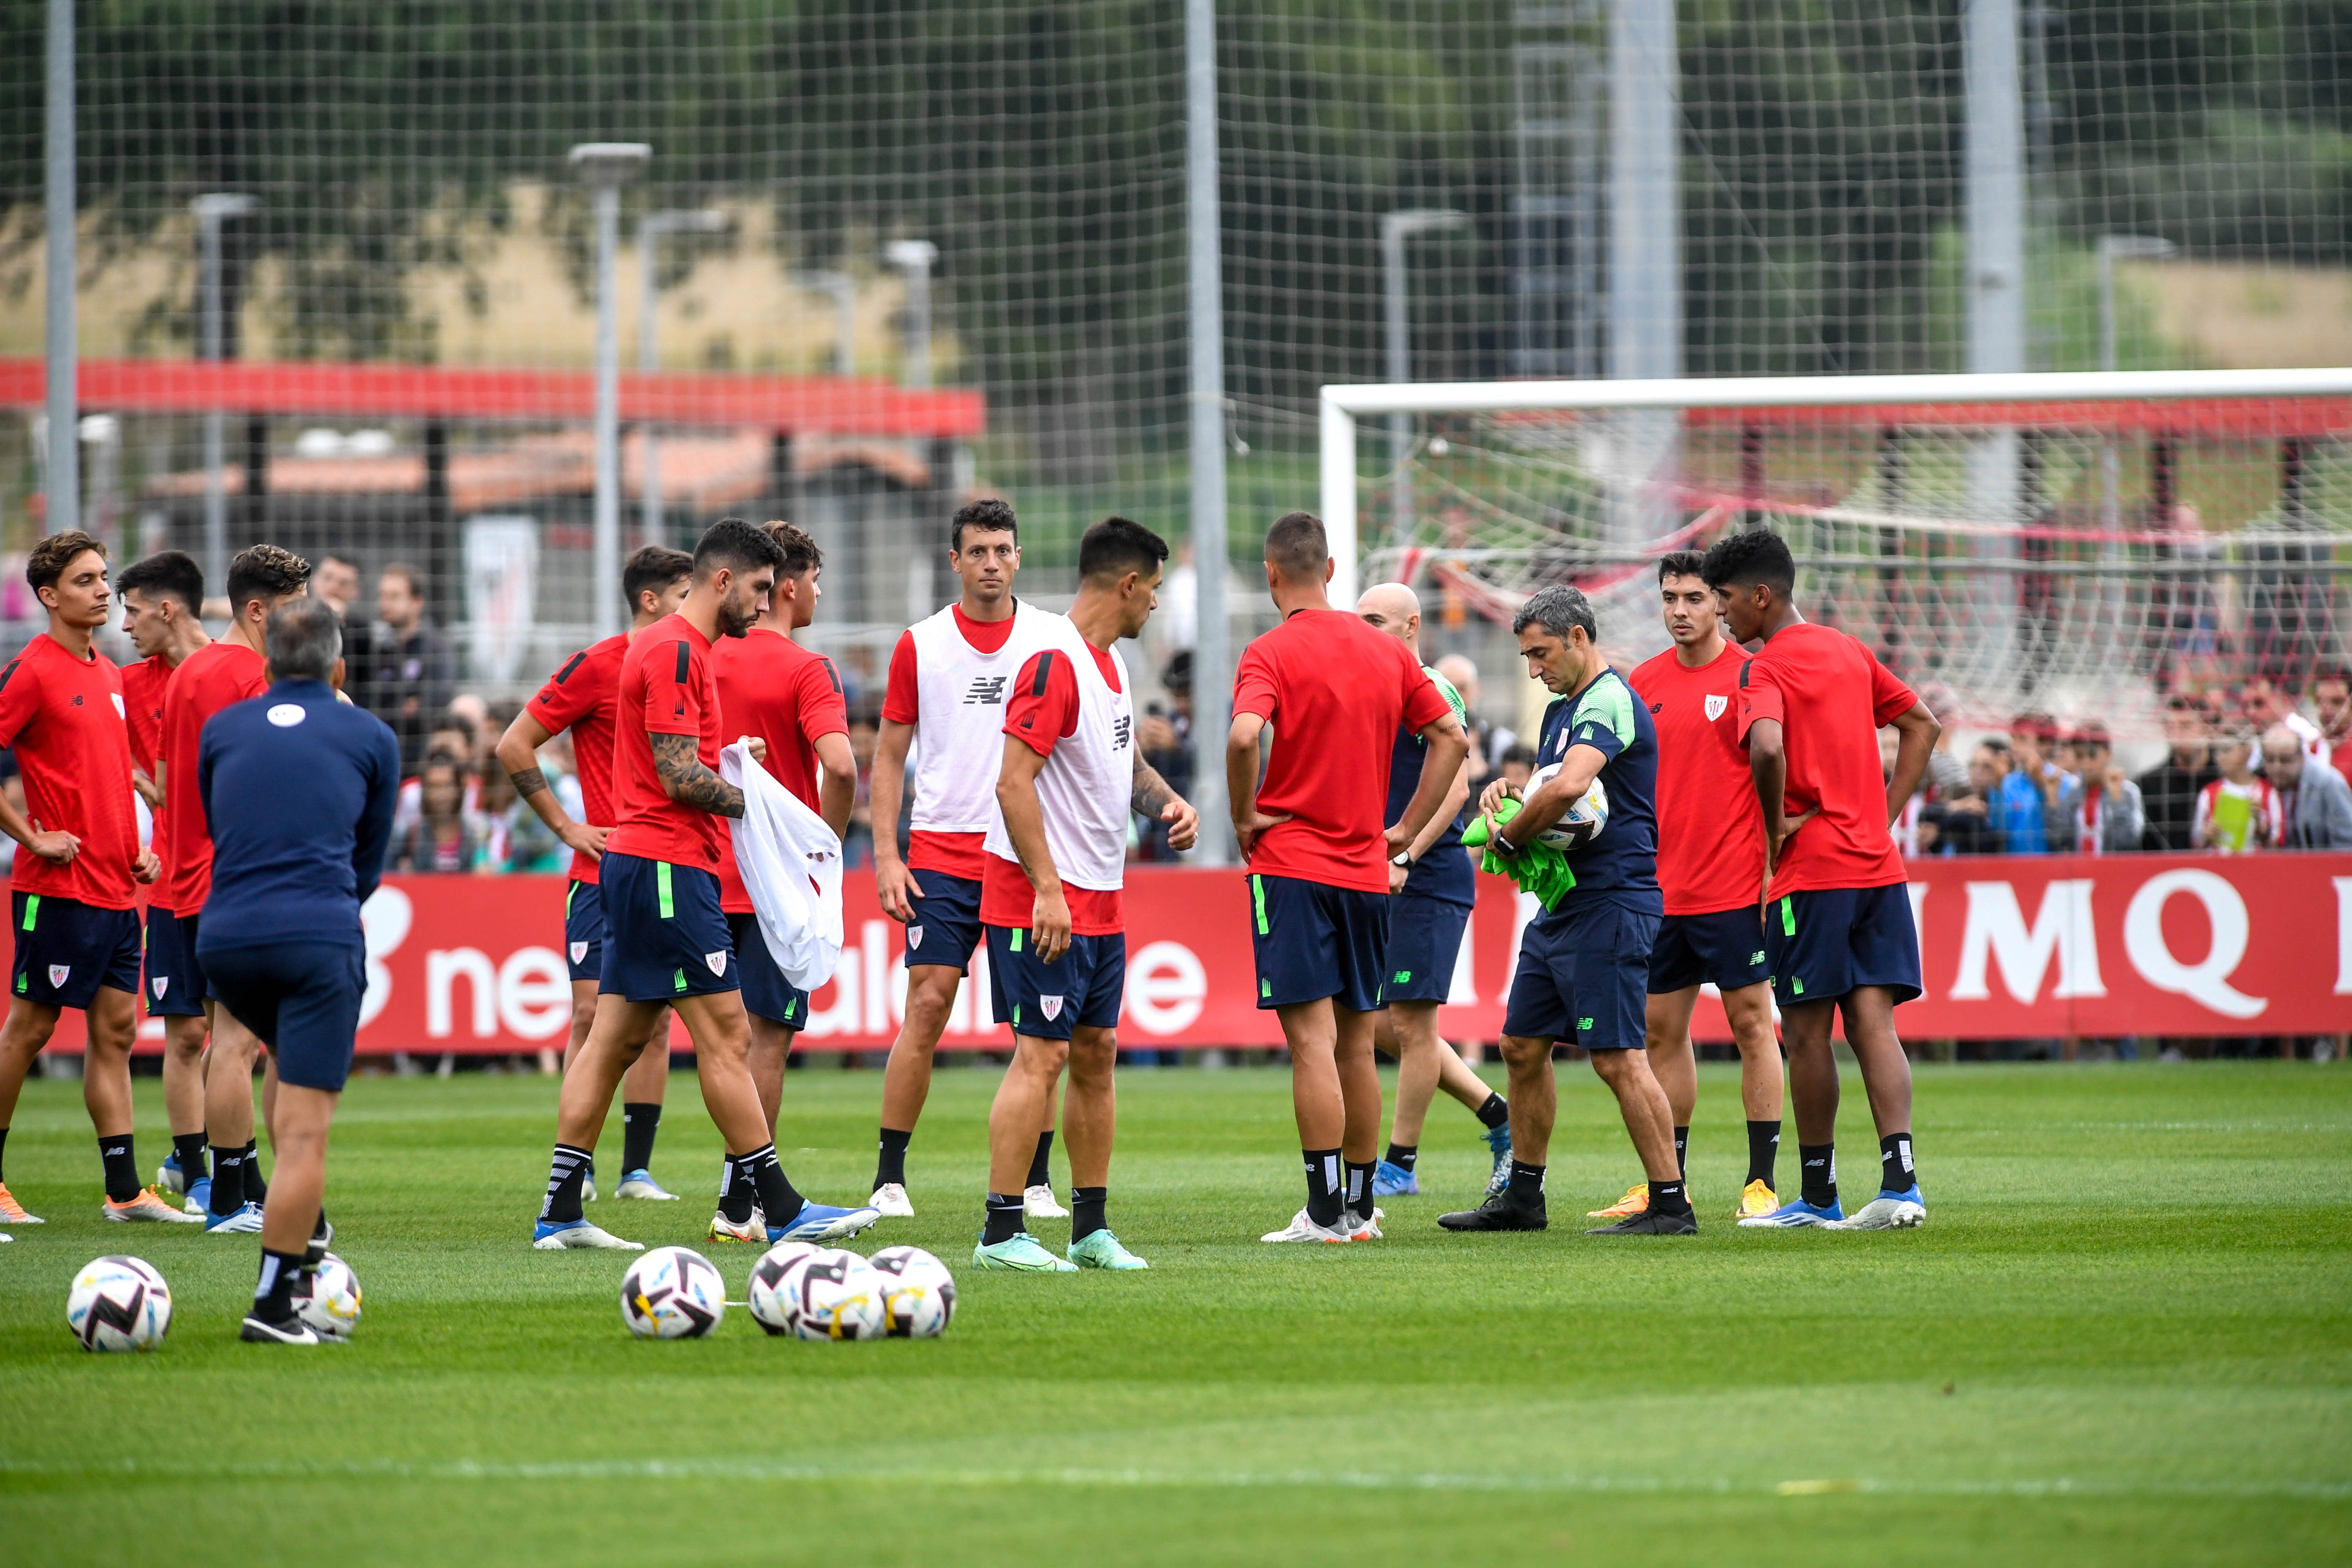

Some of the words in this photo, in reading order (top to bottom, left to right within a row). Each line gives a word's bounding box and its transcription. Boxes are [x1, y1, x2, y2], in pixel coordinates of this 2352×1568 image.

[1749, 950, 1765, 966] NB
[1392, 971, 1411, 983] NB
[1576, 1018, 1594, 1030] NB
